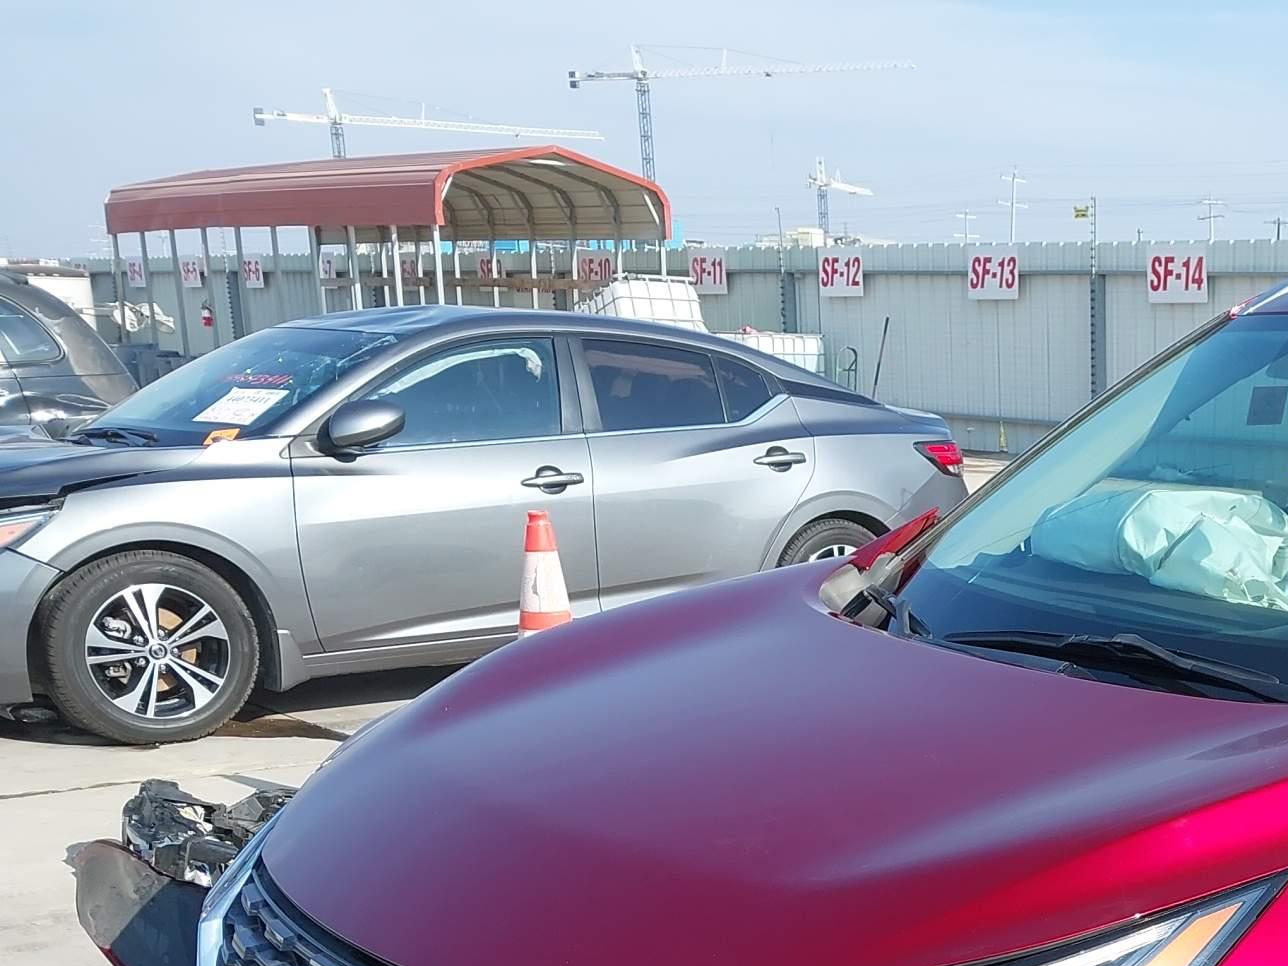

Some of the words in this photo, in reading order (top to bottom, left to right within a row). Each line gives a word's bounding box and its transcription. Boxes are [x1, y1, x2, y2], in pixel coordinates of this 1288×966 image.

[243, 260, 260, 282] SF-6
[692, 257, 723, 286] SF-11
[821, 256, 860, 288] SF-12
[970, 256, 1016, 290] SF-13
[1149, 254, 1204, 292] SF-14
